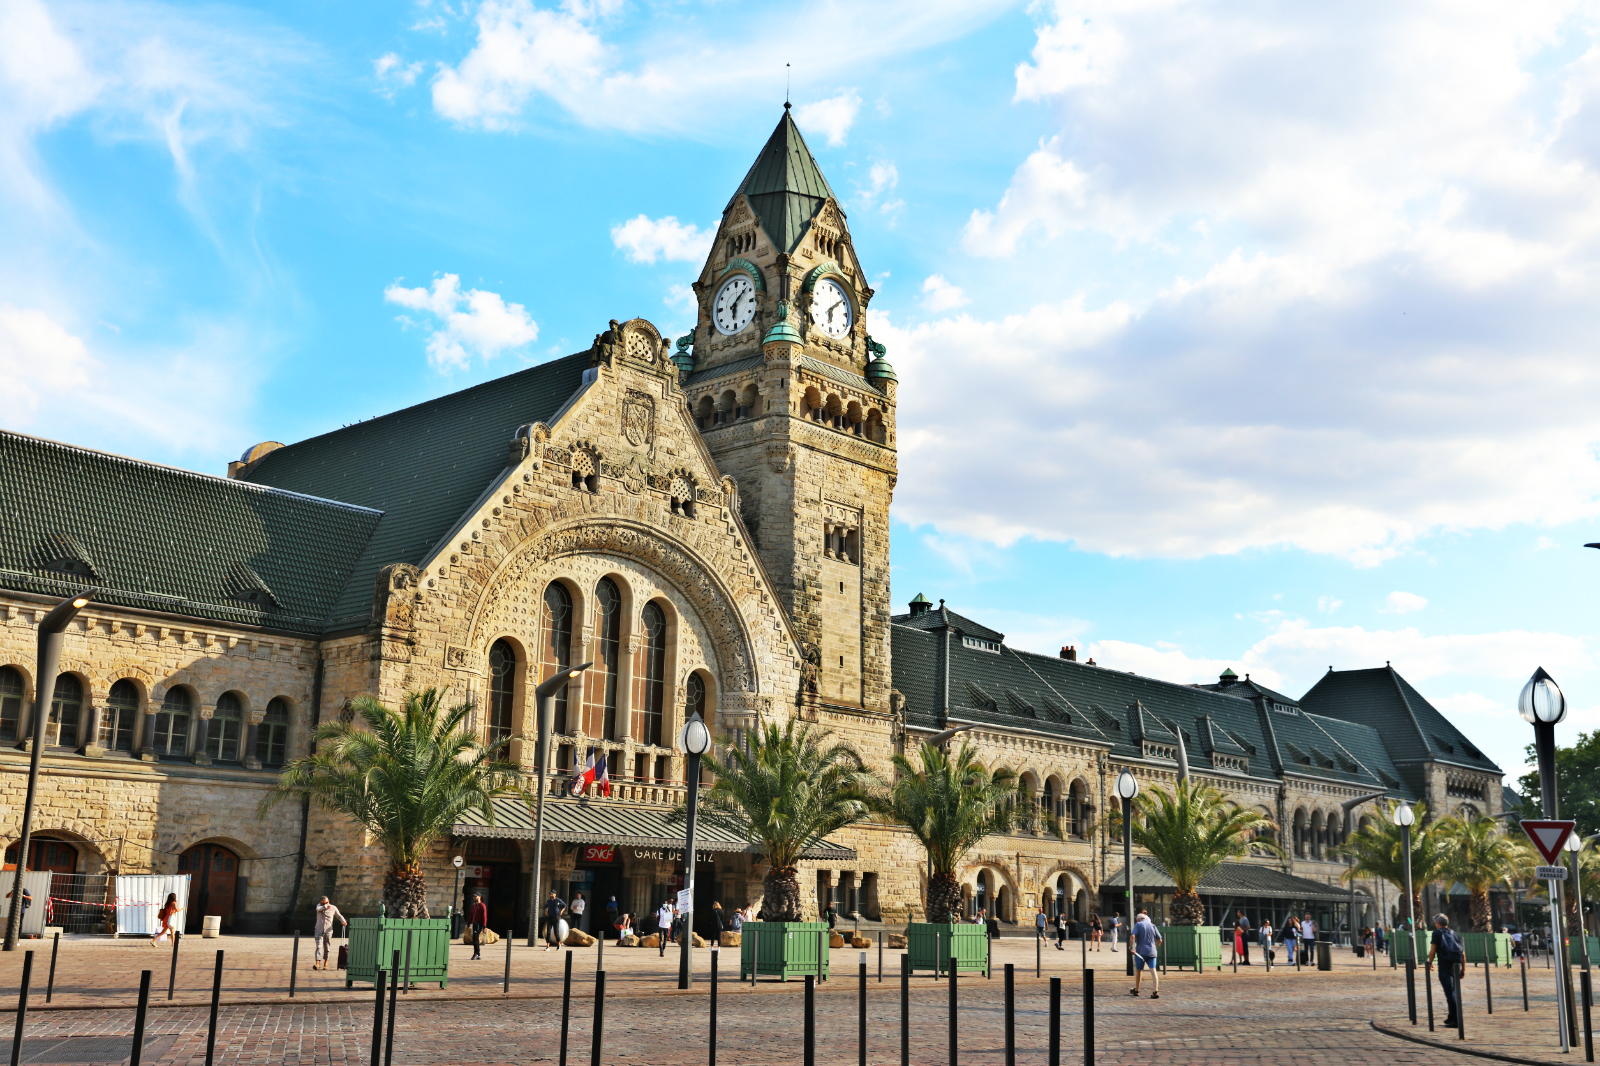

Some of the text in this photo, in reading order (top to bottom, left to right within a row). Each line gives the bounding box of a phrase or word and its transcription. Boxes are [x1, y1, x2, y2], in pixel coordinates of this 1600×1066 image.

[586, 848, 613, 859] SNCF
[634, 848, 714, 862] GARE DE ETZ
